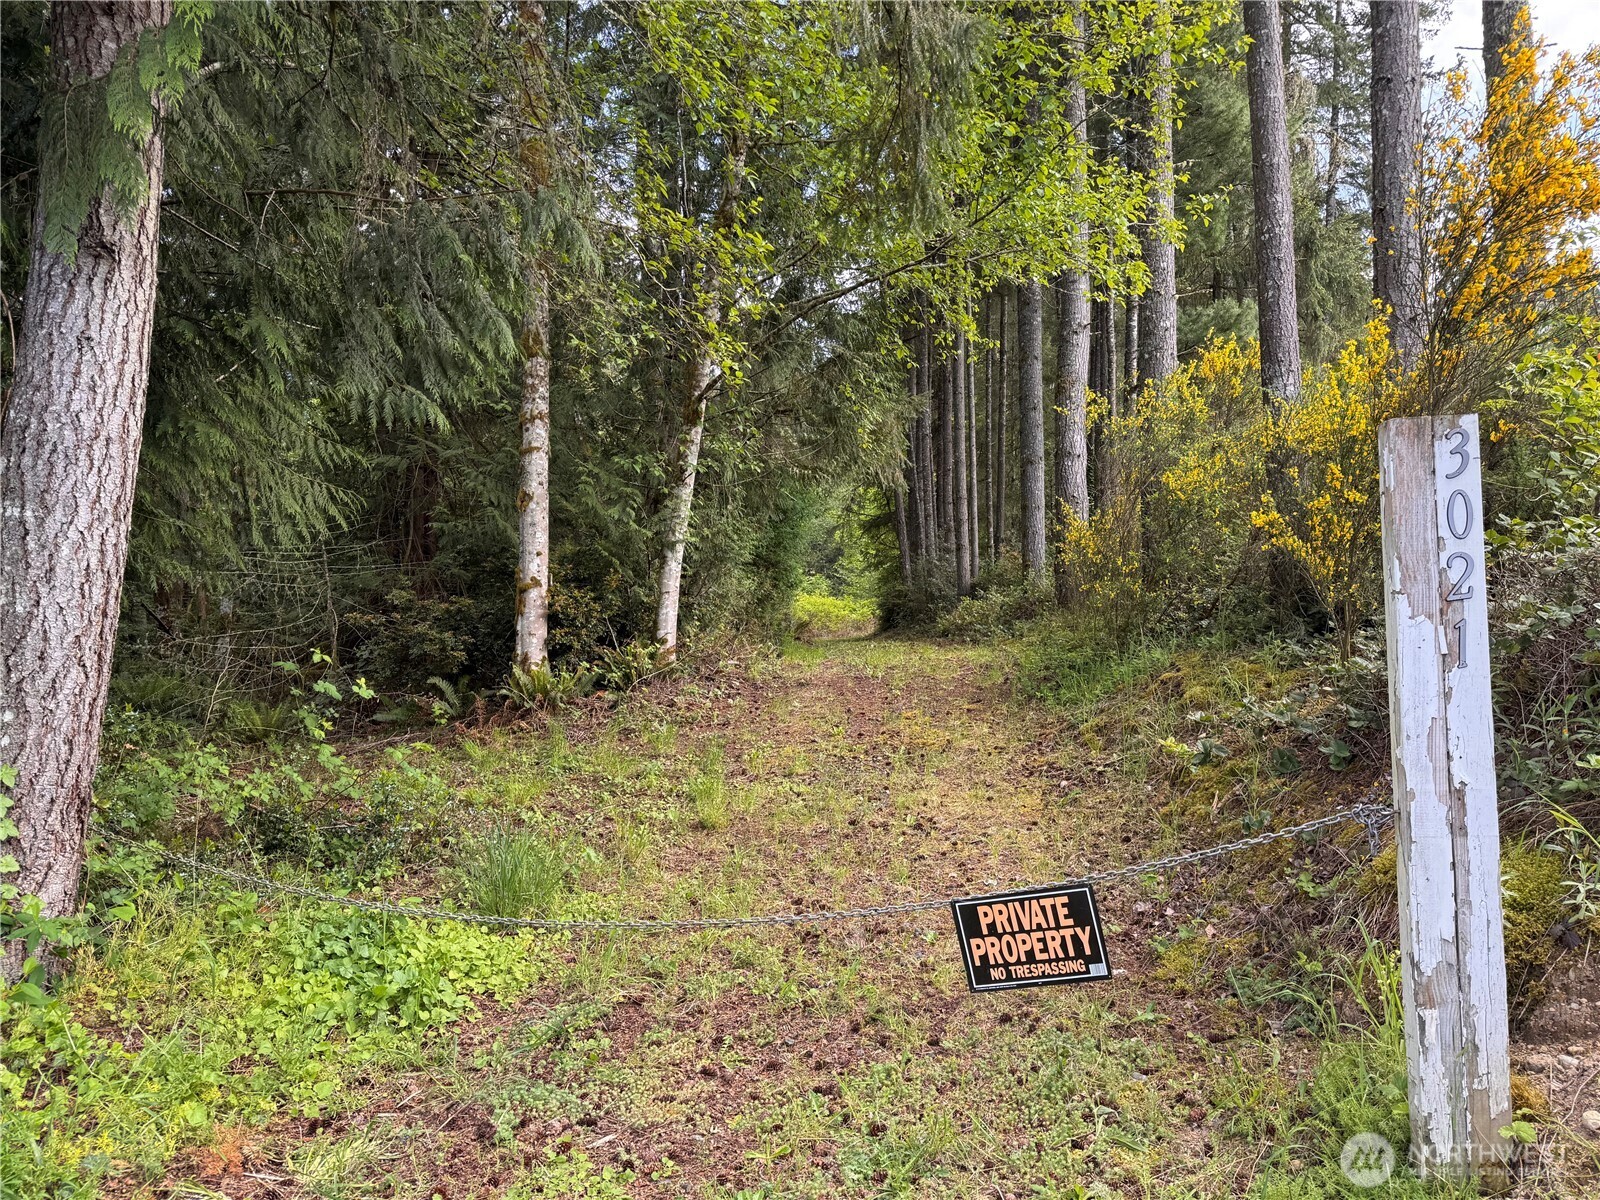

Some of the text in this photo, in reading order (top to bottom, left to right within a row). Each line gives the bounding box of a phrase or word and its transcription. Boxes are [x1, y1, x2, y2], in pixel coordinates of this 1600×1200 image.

[1445, 428, 1475, 669] 3021
[976, 896, 1074, 935] PRIVATE
[969, 926, 1092, 967] PROPERTY
[989, 959, 1087, 981] NO TRESPASSING
